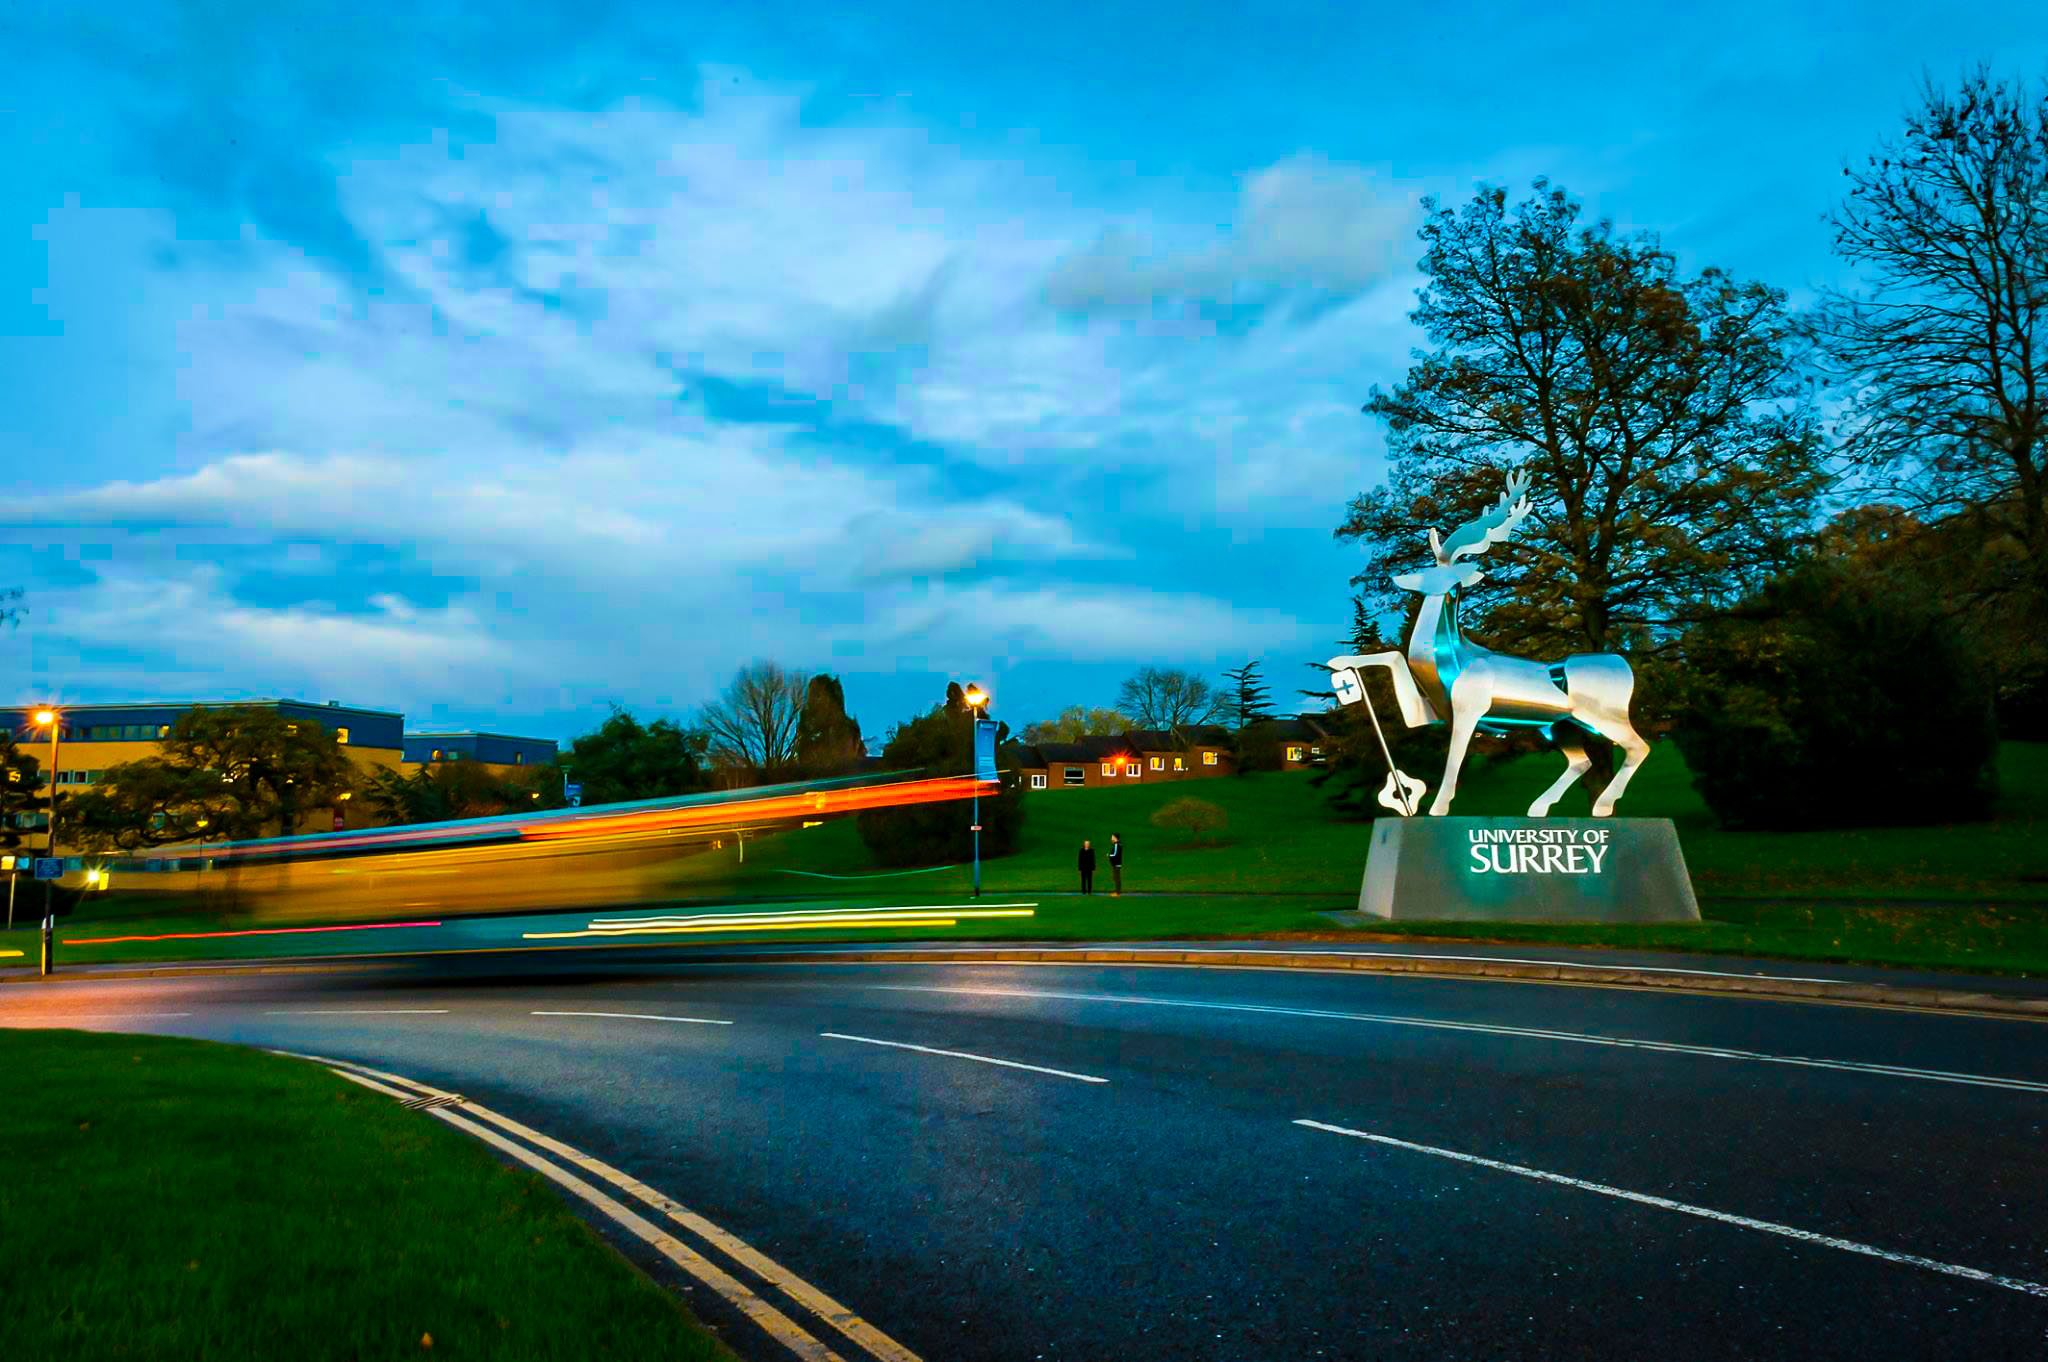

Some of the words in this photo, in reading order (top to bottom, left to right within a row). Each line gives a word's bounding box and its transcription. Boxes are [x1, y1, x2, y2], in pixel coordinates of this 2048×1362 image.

[1469, 829, 1578, 843] UNIVERSITY
[1583, 829, 1609, 844] OF
[1470, 844, 1609, 873] SURREY
